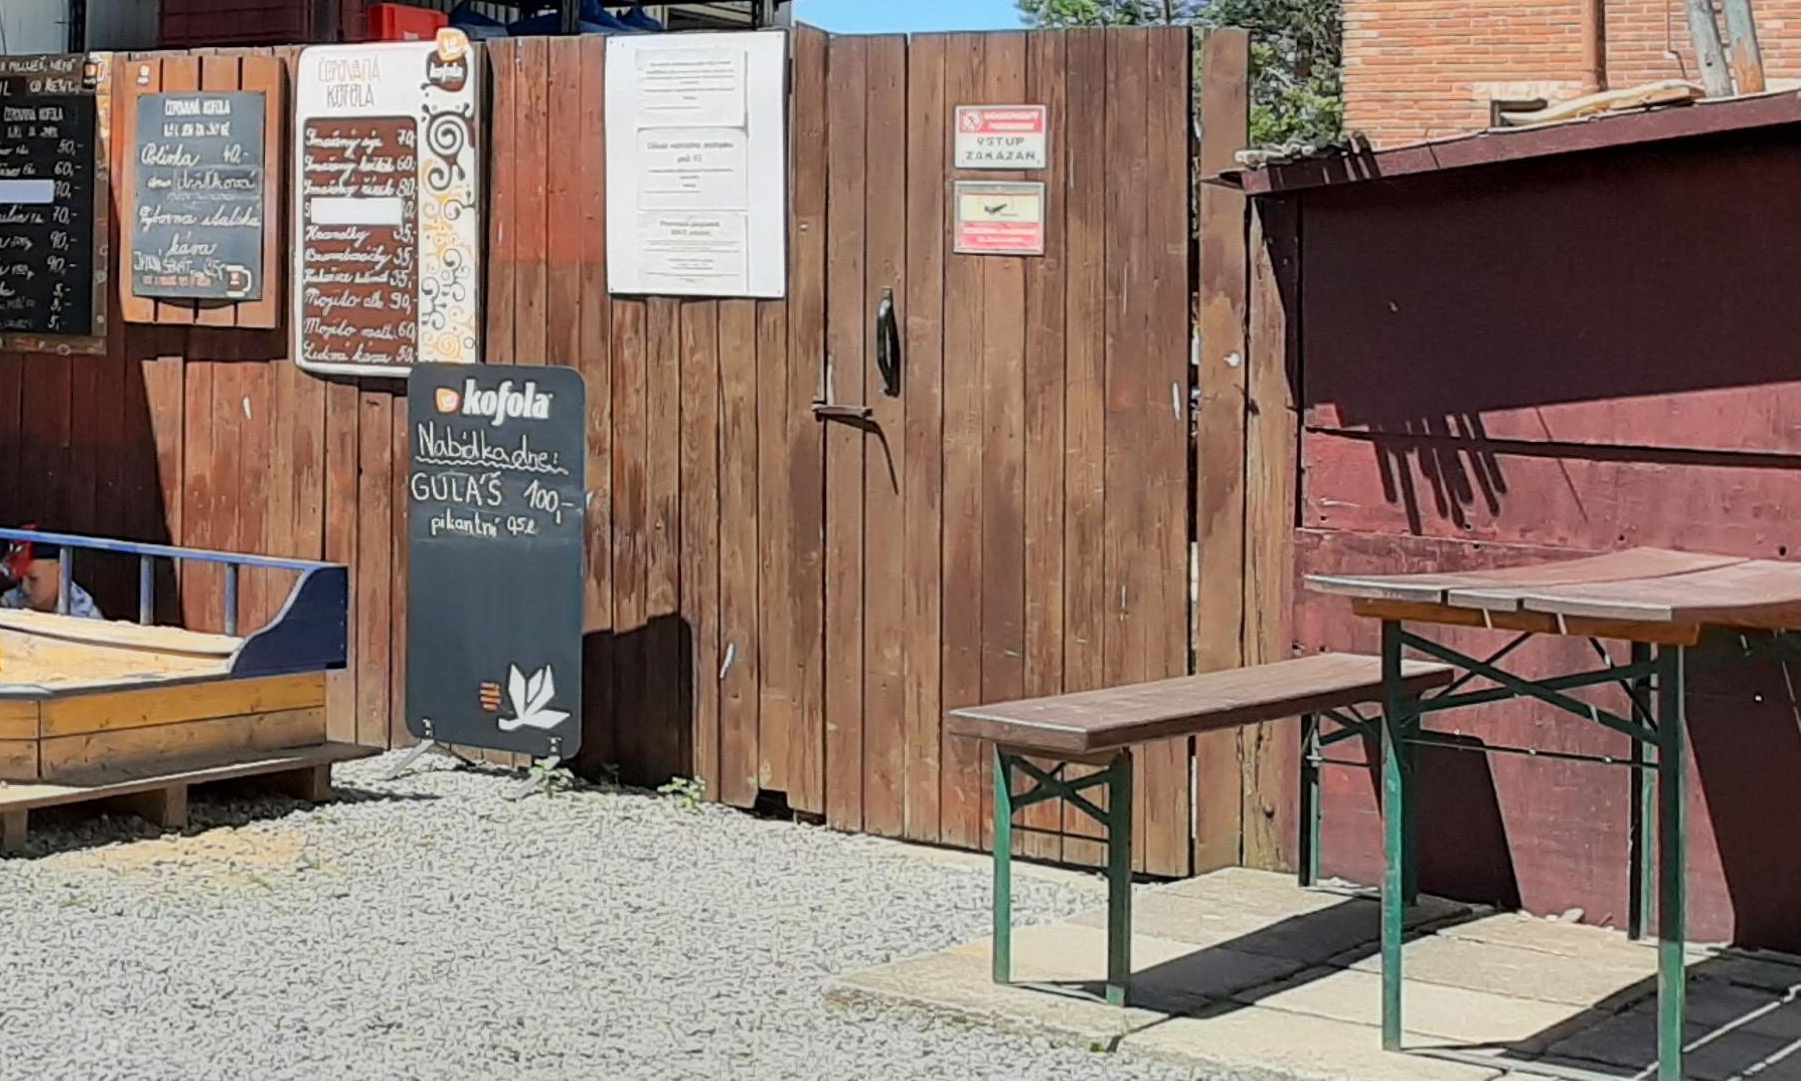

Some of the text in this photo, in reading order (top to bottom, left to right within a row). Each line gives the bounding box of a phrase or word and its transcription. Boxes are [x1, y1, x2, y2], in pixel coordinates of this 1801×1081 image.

[327, 84, 375, 108] KOFOLA
[977, 136, 1026, 147] VSTUP
[462, 378, 553, 426] kofola
[417, 420, 511, 464] Nabídka
[410, 470, 504, 507] GULÁŠ
